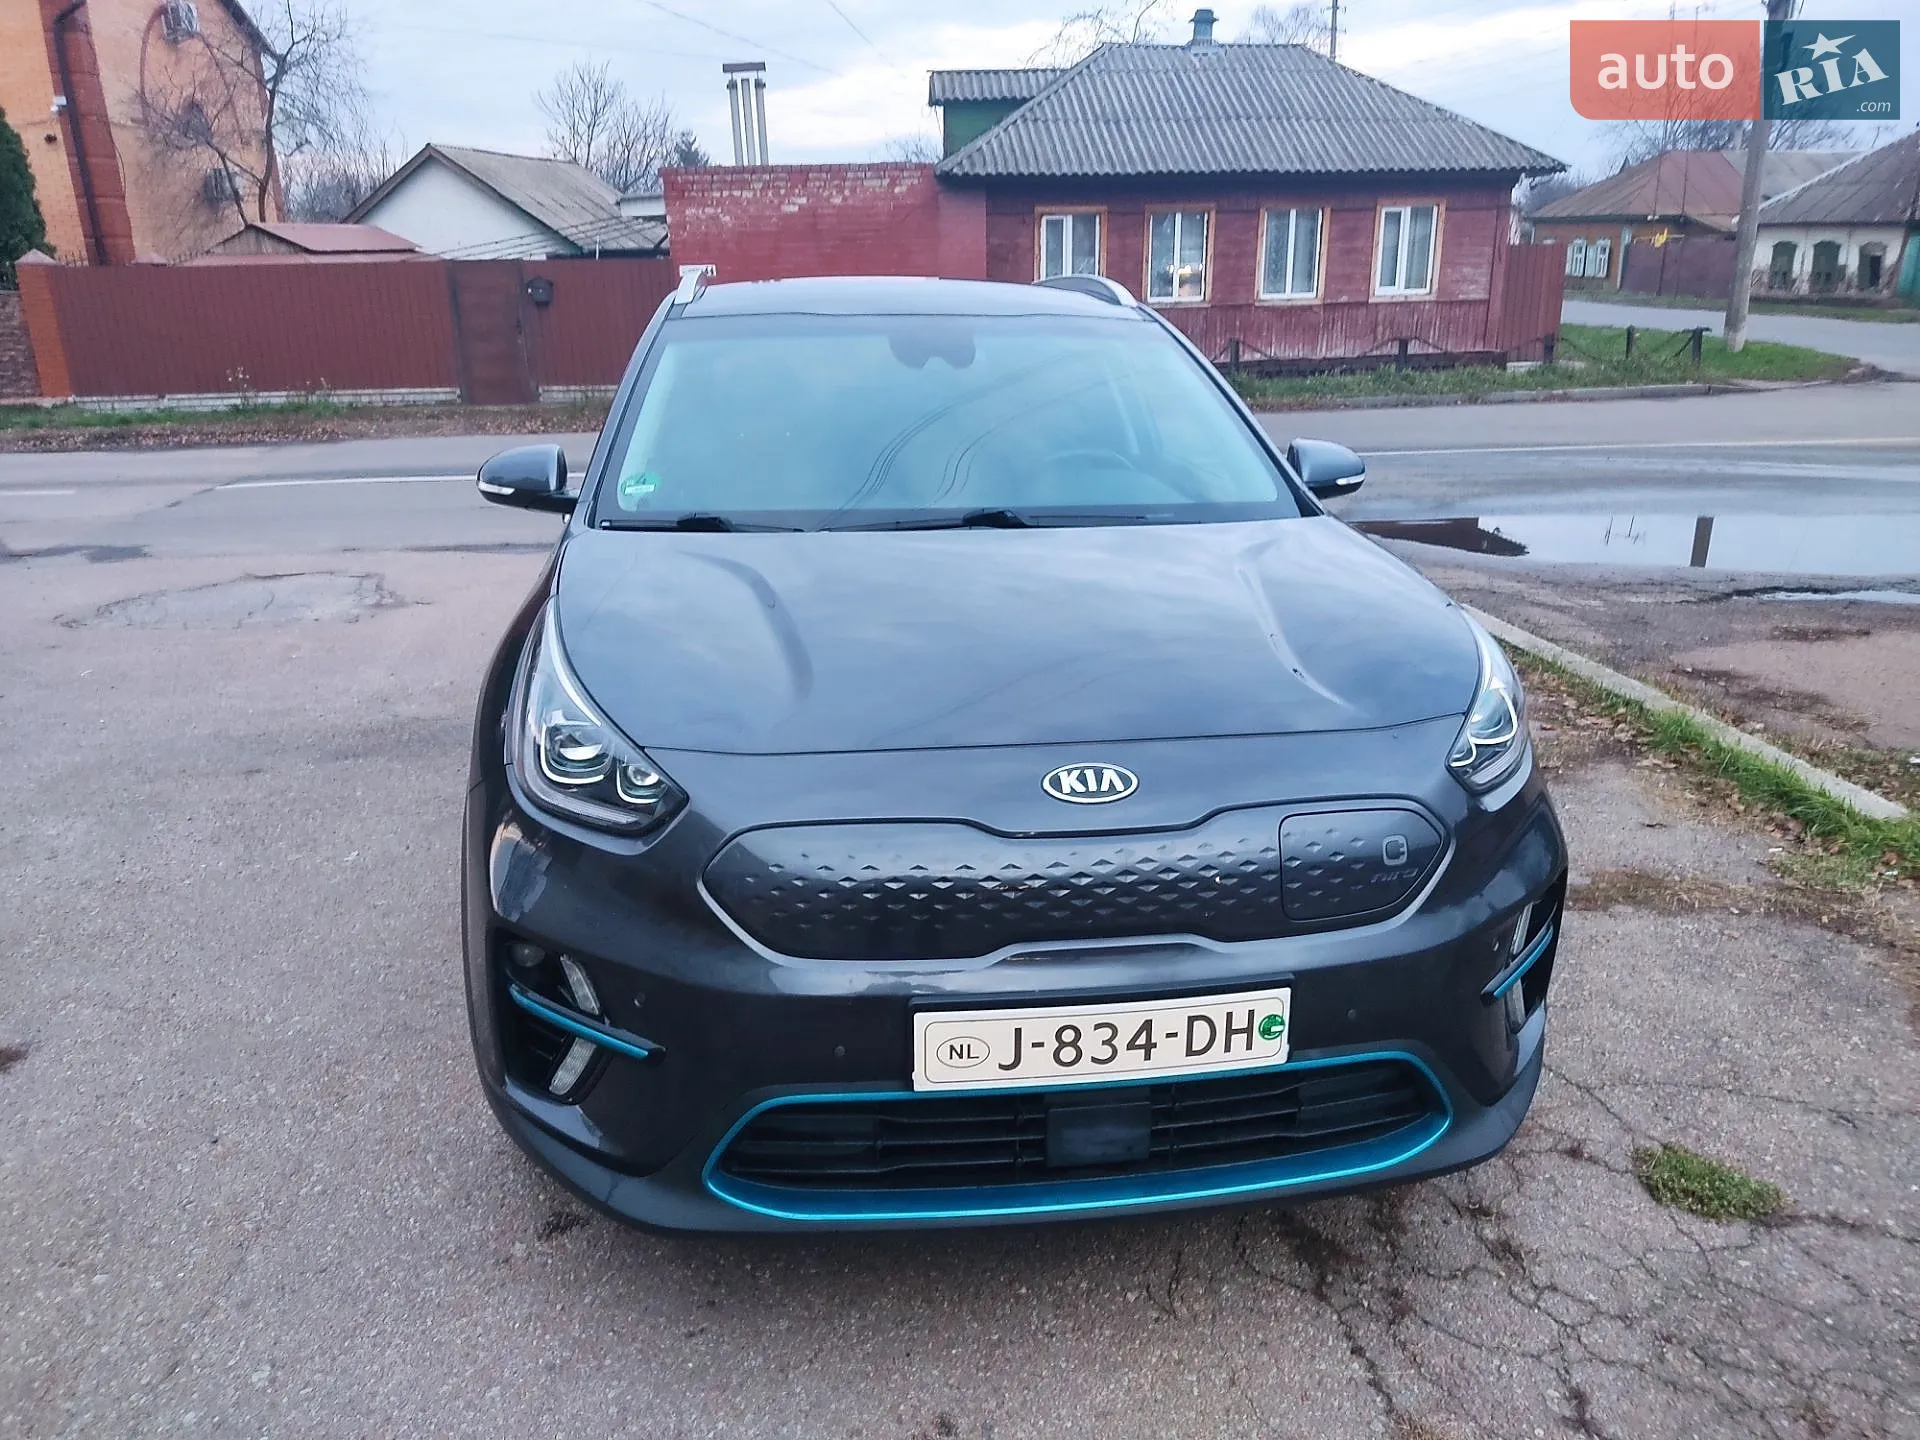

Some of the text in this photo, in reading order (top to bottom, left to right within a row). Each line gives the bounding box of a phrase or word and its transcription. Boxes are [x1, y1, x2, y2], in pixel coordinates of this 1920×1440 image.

[1057, 768, 1125, 794] KIA
[948, 1008, 1256, 1072] NL J-834-DH
